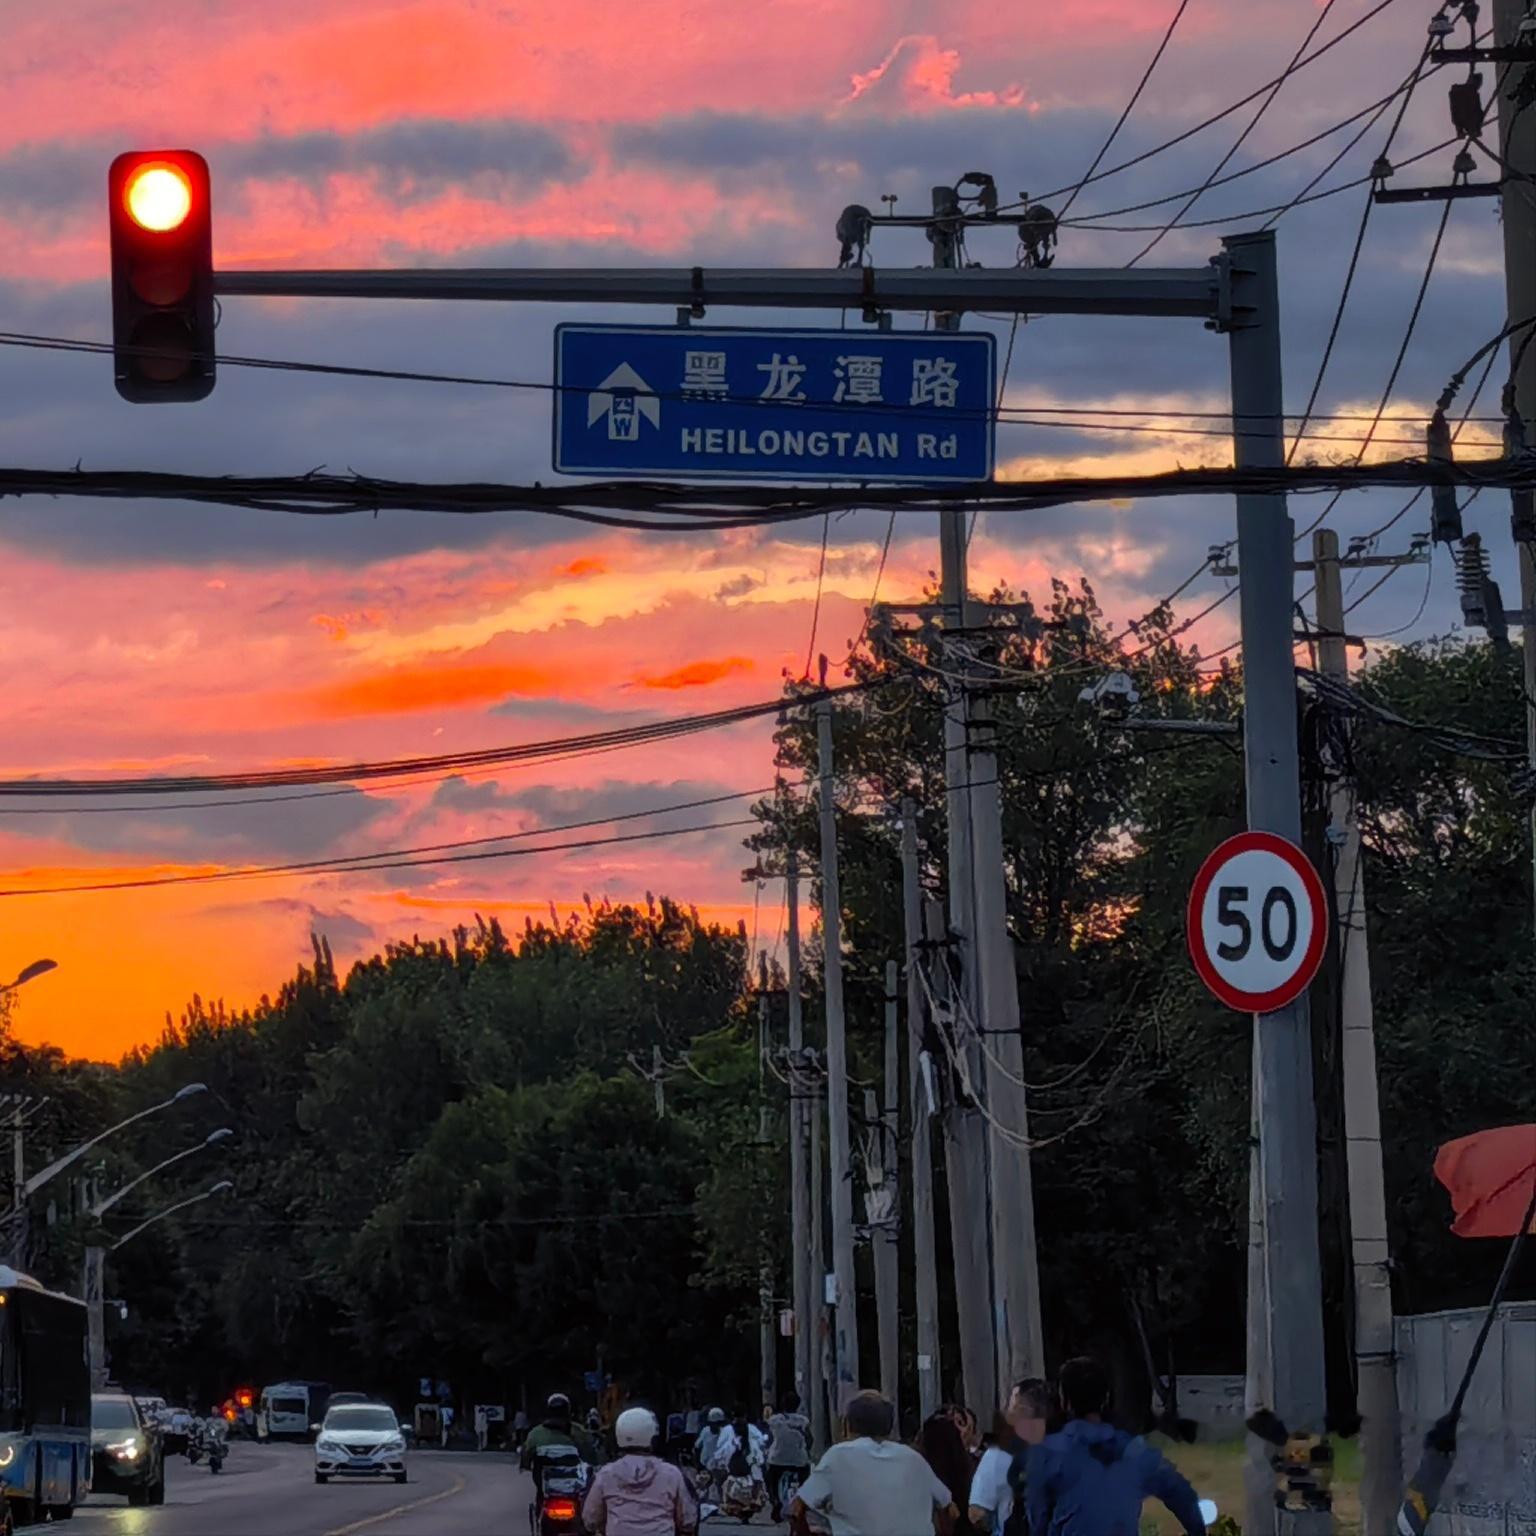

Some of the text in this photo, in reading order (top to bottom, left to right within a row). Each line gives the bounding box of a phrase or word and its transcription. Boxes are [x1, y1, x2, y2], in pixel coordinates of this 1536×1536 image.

[680, 351, 959, 407] 黑龙潭路
[613, 417, 633, 437] W
[681, 428, 958, 458] HEILONGTAN Rd
[1217, 886, 1297, 961] 50
